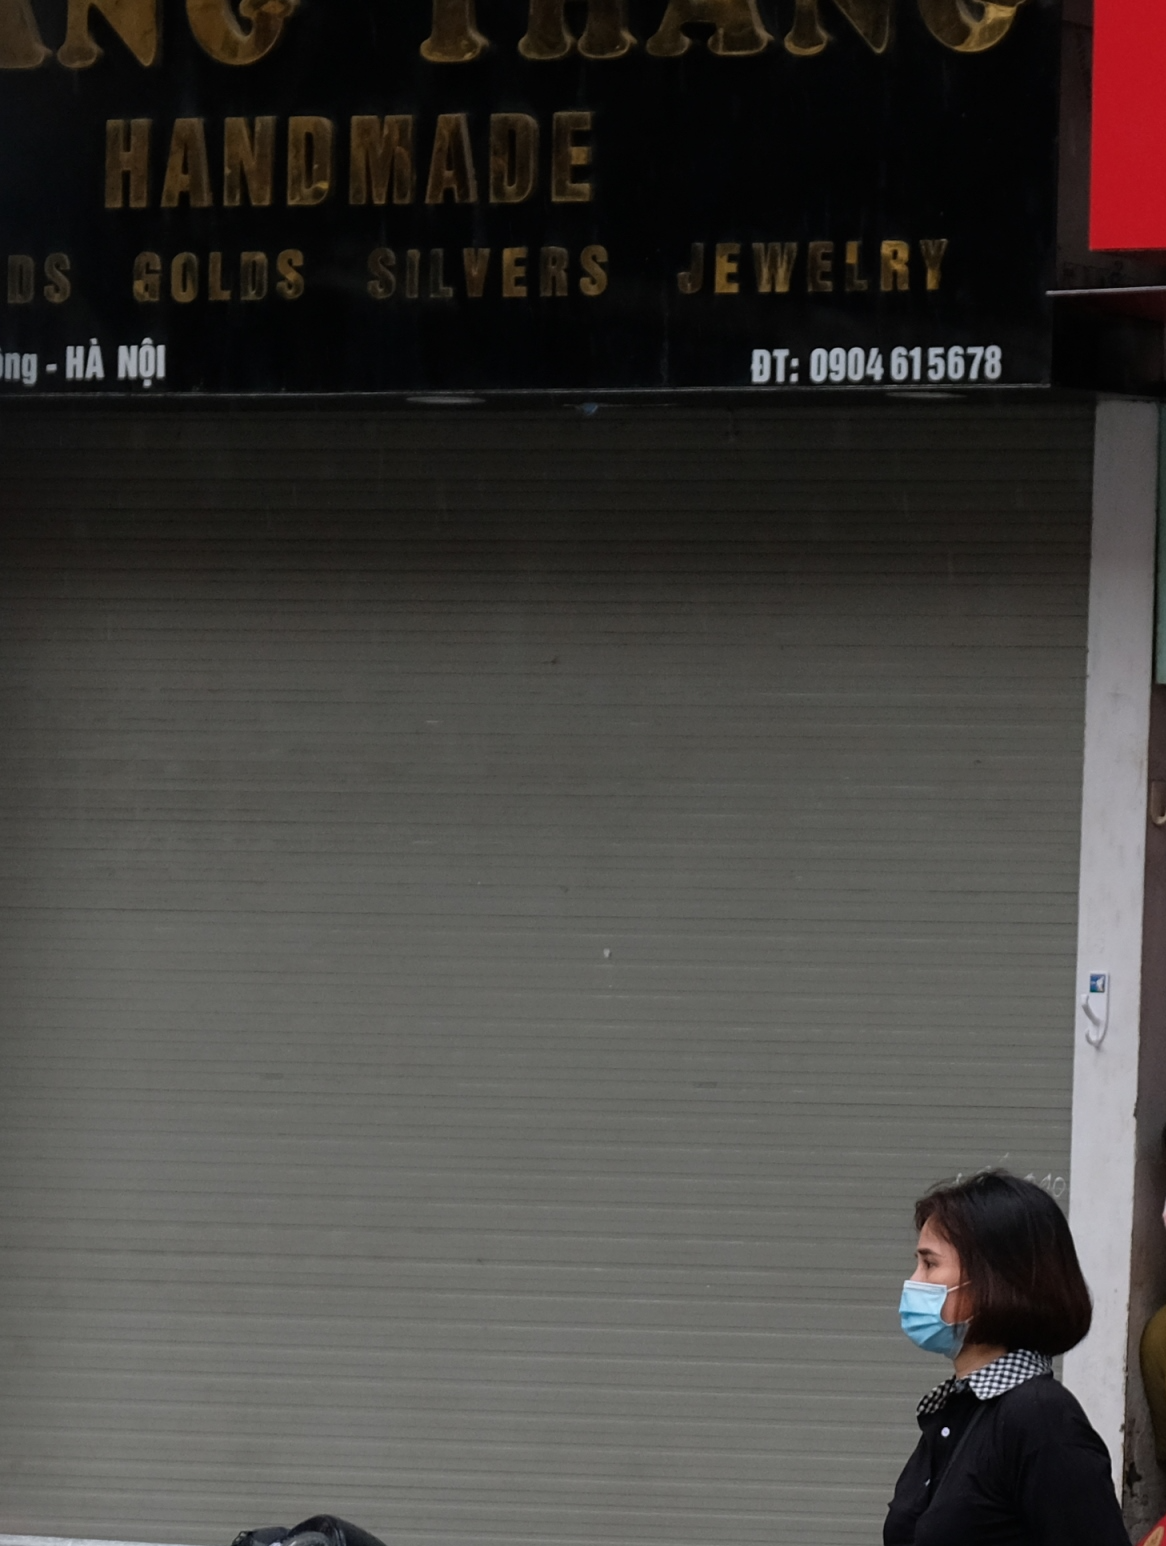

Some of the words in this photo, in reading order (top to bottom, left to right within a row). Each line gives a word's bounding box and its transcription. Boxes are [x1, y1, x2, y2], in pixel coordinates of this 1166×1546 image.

[104, 111, 595, 208] HANDMADE
[133, 249, 305, 302] GOLDS
[366, 245, 609, 298] SILVERS
[677, 239, 948, 294] JEWELRY
[0, 347, 38, 386] ng
[65, 338, 105, 380] HÀ
[117, 337, 166, 388] NỘI
[751, 348, 799, 383] ĐT:
